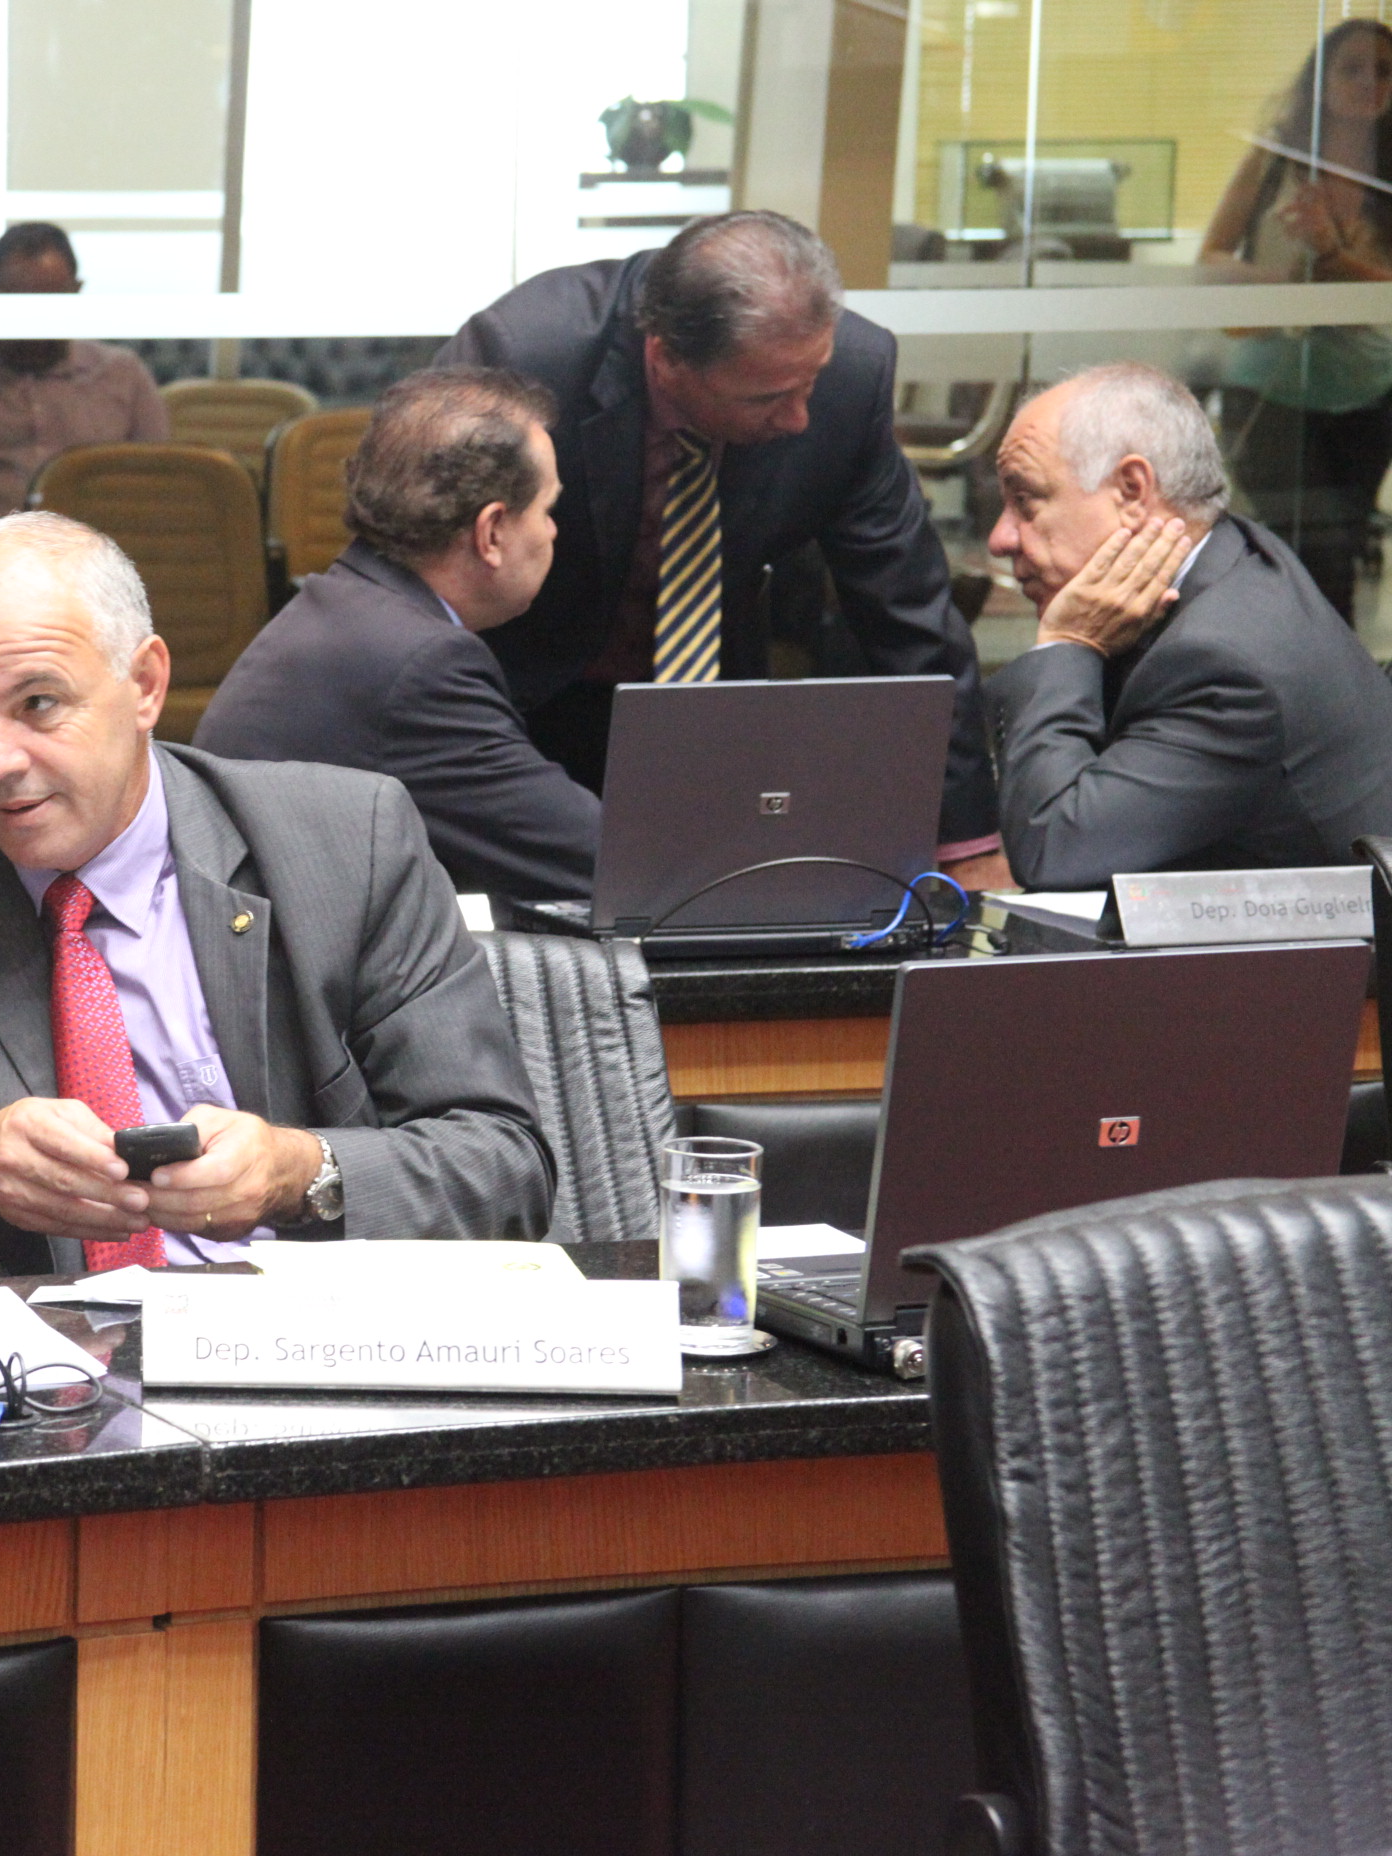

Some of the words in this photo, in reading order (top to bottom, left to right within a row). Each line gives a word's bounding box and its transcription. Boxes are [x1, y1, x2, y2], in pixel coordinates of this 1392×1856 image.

[1190, 901, 1237, 922] Dep.
[194, 1336, 259, 1366] Dep.
[275, 1336, 406, 1367] Sargento
[415, 1339, 521, 1363] Amauri
[533, 1339, 631, 1364] Soares
